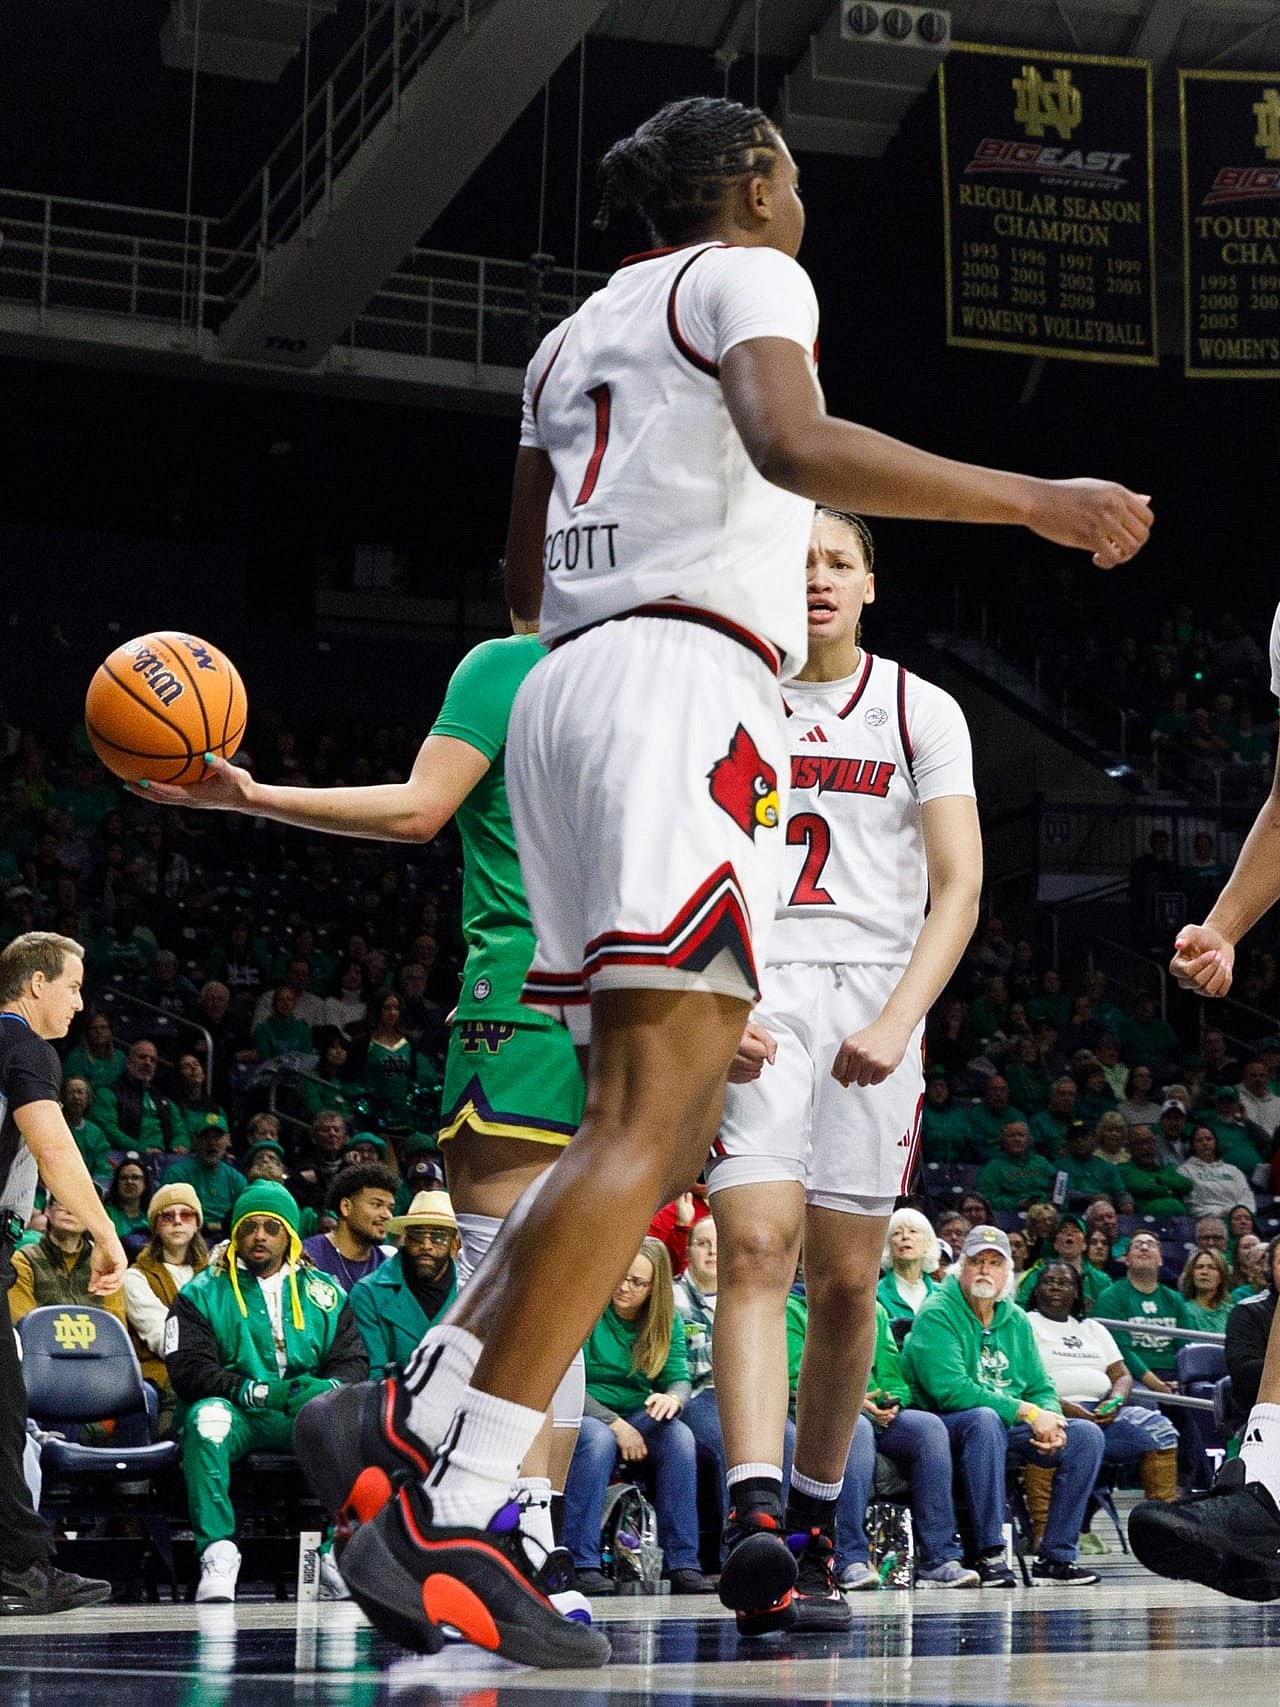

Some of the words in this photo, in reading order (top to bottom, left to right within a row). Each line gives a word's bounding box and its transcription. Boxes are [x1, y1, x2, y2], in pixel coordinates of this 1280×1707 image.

[960, 184, 1057, 216] REGULAR
[1063, 197, 1142, 223] SEASON
[994, 213, 1109, 247] CHAMPION
[962, 241, 998, 259] 1995
[1011, 247, 1046, 267] 1996
[1061, 253, 1093, 271] 1997
[961, 261, 1000, 280] 2000
[1010, 267, 1045, 286] 2001
[1059, 272, 1094, 292] 2002
[1106, 277, 1141, 295] 2003
[1199, 275, 1238, 290] 1995
[961, 281, 999, 299] 2004
[1060, 293, 1095, 310] 2009
[1199, 294, 1239, 310] 2000
[961, 305, 1039, 336] WOMEN'S
[1043, 316, 1146, 346] VOLLEYBALL
[1197, 338, 1280, 360] WOMEN'S
[785, 812, 836, 906] 2
